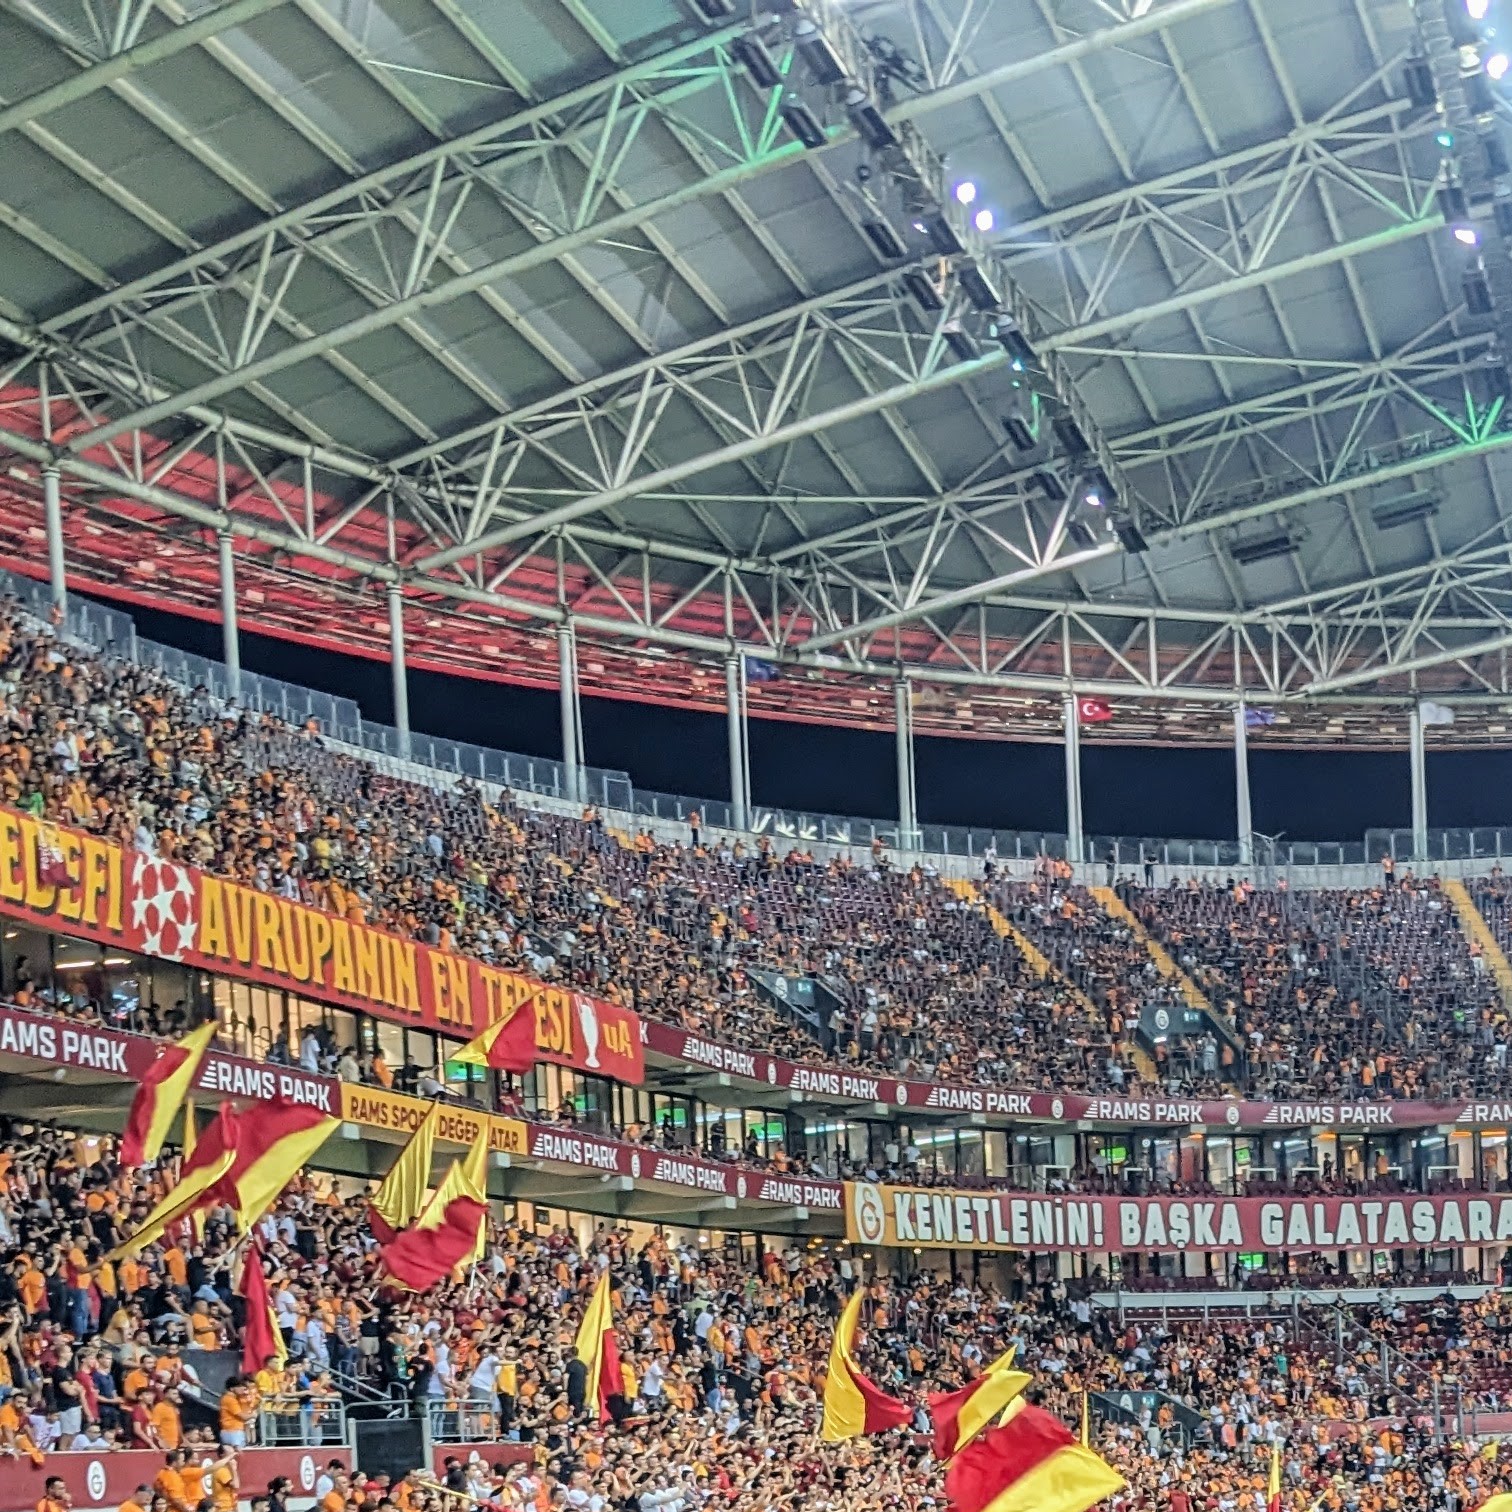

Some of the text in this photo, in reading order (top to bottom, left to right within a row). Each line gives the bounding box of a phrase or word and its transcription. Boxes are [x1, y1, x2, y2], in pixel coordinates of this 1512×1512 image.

[199, 876, 421, 1012] AVRUPANIN
[428, 951, 473, 1026] EN
[62, 1030, 128, 1073] PARK
[691, 1038, 755, 1078] RAMS PARK
[217, 1060, 331, 1112] RAMS PARK
[800, 1069, 879, 1101] RAMS PARK
[938, 1087, 1032, 1115] RAMS PARK
[351, 1096, 389, 1126] RAMS
[490, 1127, 518, 1151] ATAR
[1100, 1101, 1203, 1123] RAMS PARK
[1280, 1105, 1393, 1124] RAMS PARK
[544, 1134, 618, 1170] RAMS PARK
[663, 1159, 726, 1193] RAMS PARK
[769, 1181, 841, 1209] RAMS PARK
[1119, 1202, 1243, 1248] BAŞKA
